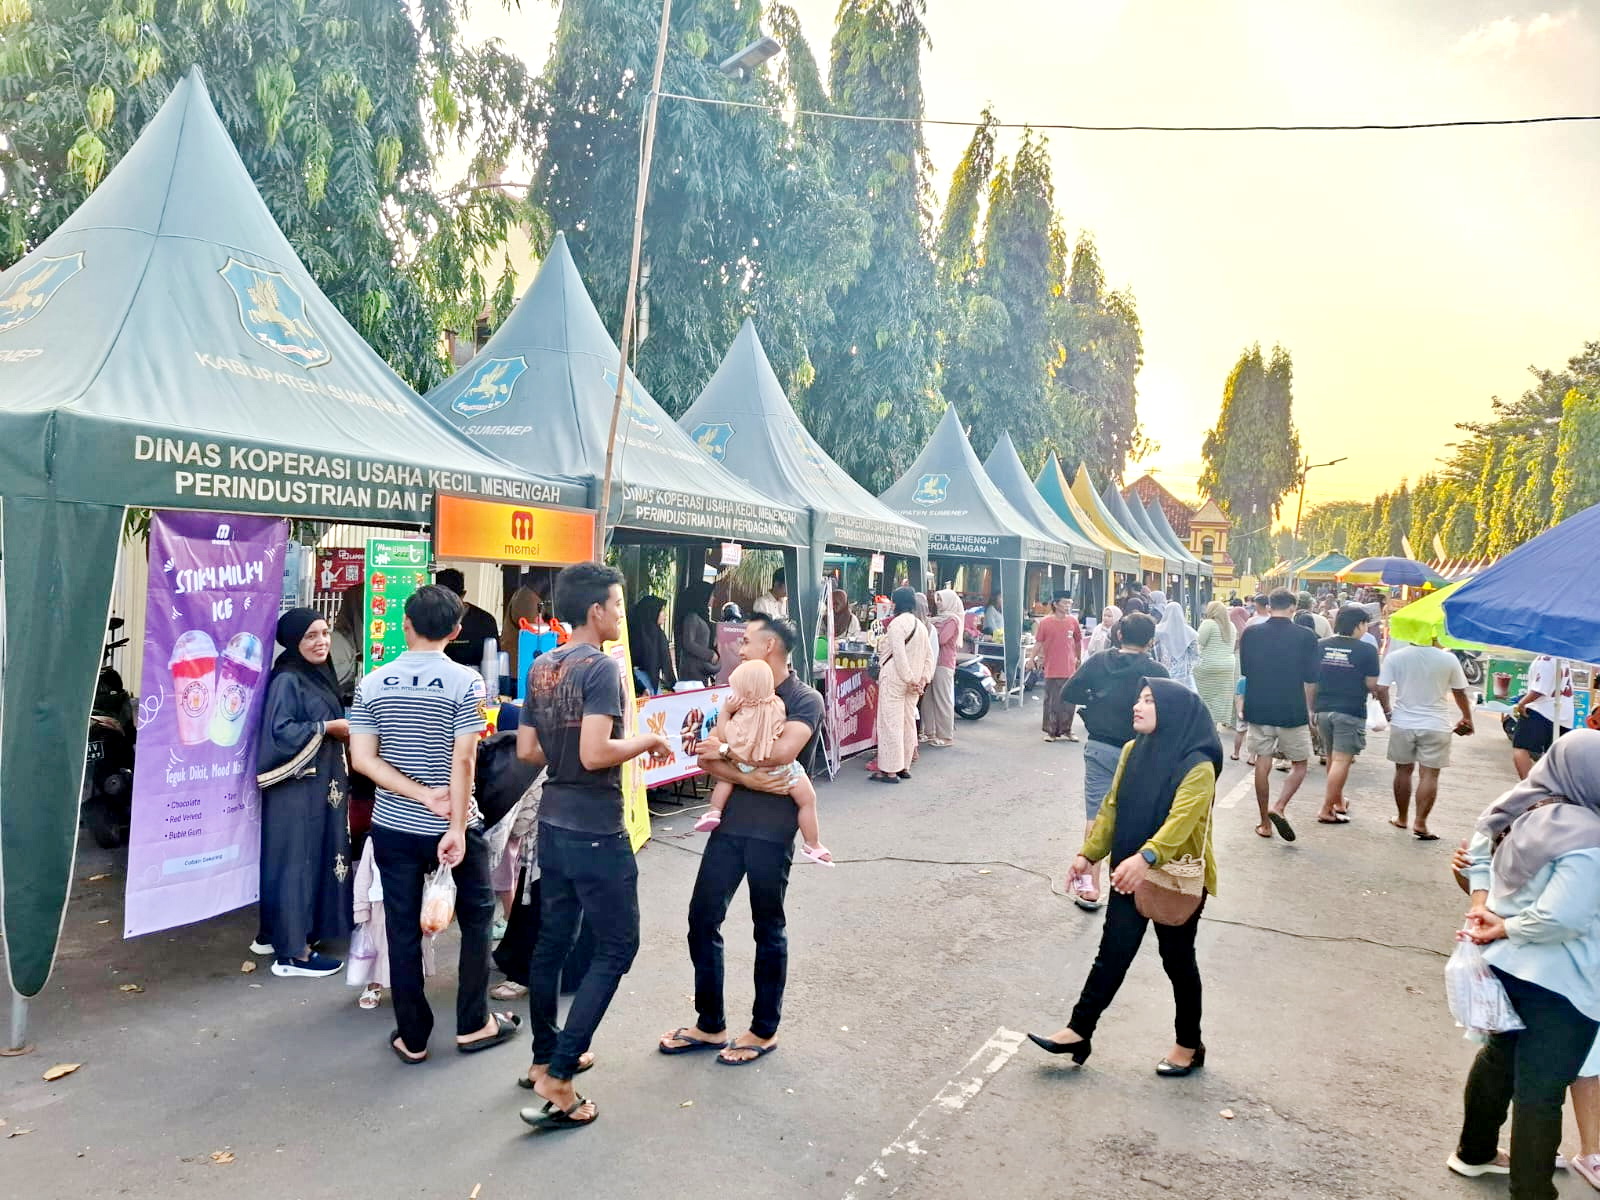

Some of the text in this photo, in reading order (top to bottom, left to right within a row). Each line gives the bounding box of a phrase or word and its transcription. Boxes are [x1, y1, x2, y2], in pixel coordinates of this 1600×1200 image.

[465, 425, 533, 436] SUMENEP
[134, 435, 561, 504] DINAS KOPERASI USAHA KECIL MENENGAH
[175, 471, 371, 508] PERINDUSTRIAN
[376, 489, 417, 510] DAN
[623, 486, 654, 504] DINAS
[656, 491, 704, 510] KOPERASI
[705, 497, 735, 514] USAHA
[735, 503, 758, 518] KECIL
[636, 505, 788, 537] PERINDUSTRIAN DAN PERDAGANGAN
[927, 543, 987, 553] ERDAGANGAN
[928, 534, 1000, 545] ECIL MENENGAH
[175, 560, 263, 594] STIKY MILKY
[212, 597, 233, 622] ICE
[166, 767, 186, 787] Teguk
[212, 761, 230, 778] Mood
[169, 815, 181, 824] Red
